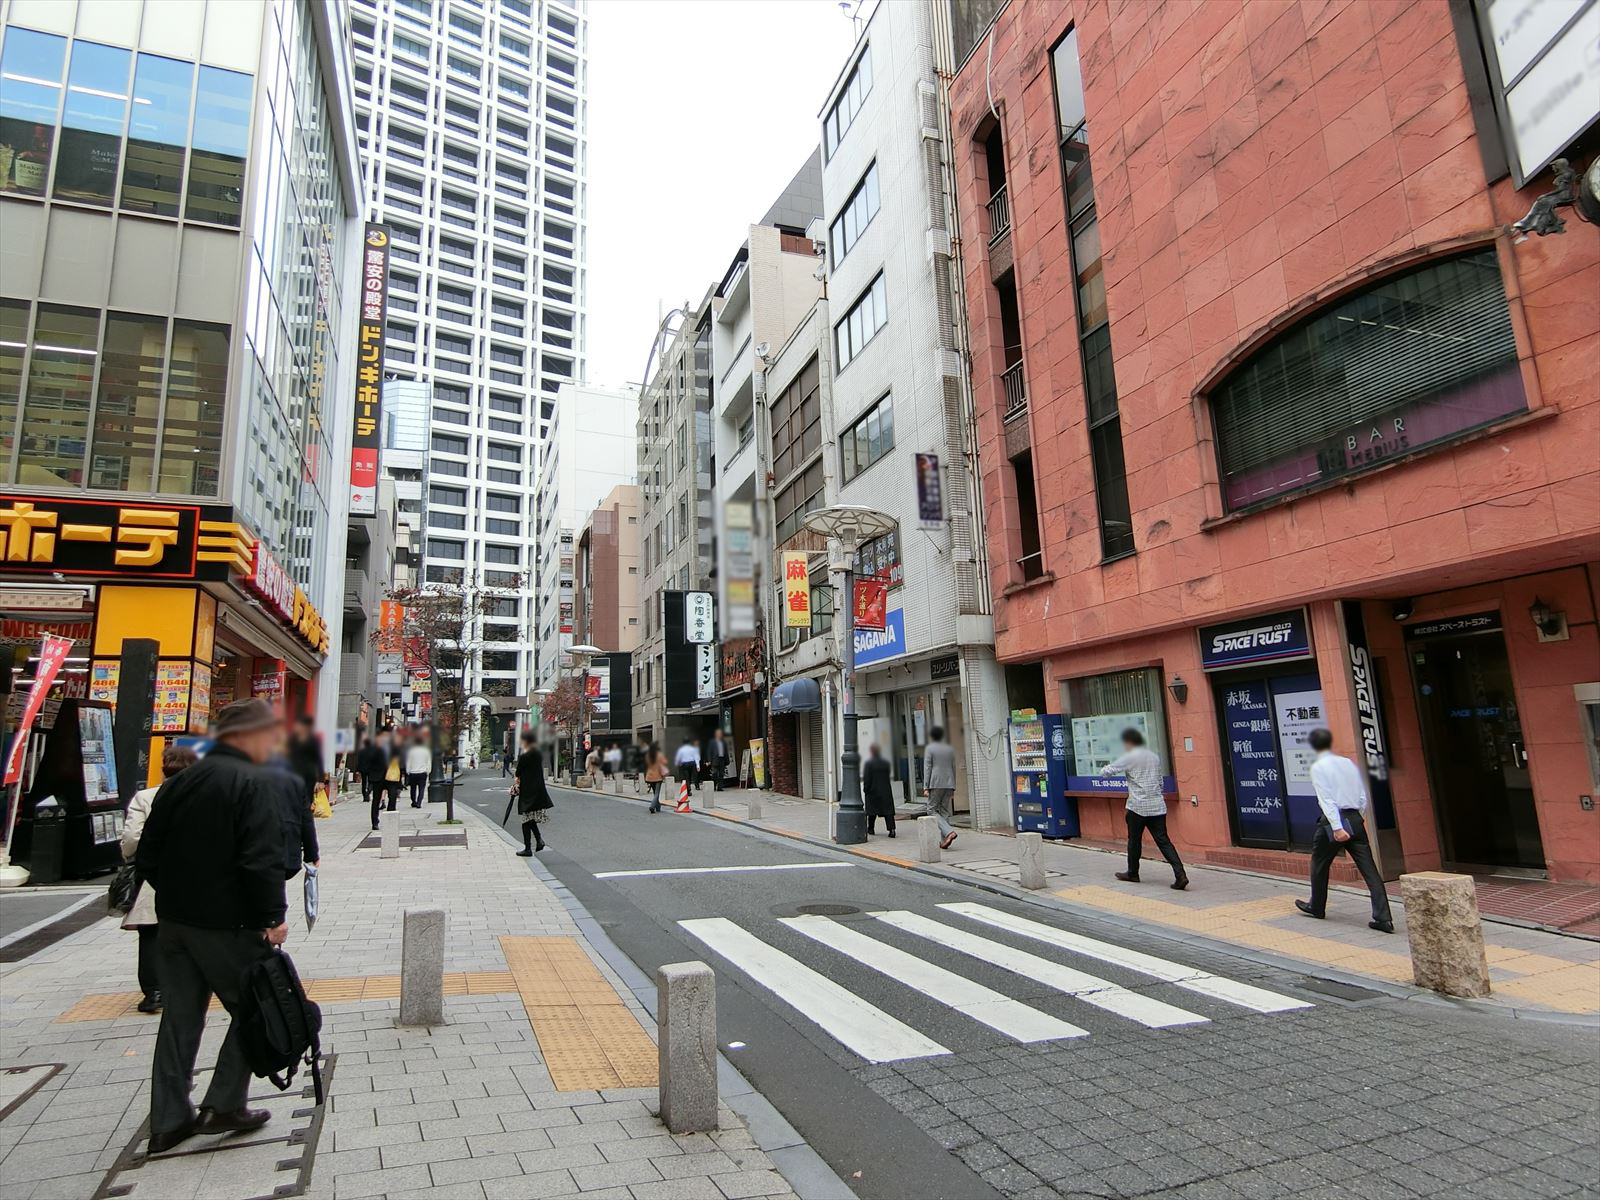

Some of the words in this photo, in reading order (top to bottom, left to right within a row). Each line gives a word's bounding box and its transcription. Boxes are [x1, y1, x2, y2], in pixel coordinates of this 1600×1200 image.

[1346, 417, 1405, 450] BAR
[786, 559, 809, 612] 麻雀
[854, 624, 897, 654] SAGAWA
[1226, 690, 1251, 706] 赤坂
[1285, 706, 1320, 720] 不動産
[1250, 719, 1271, 732] 銀座
[1052, 748, 1066, 756] BOS
[1233, 740, 1252, 753] 新宿
[1257, 768, 1277, 781] 渋谷
[1254, 797, 1281, 808] 六本木
